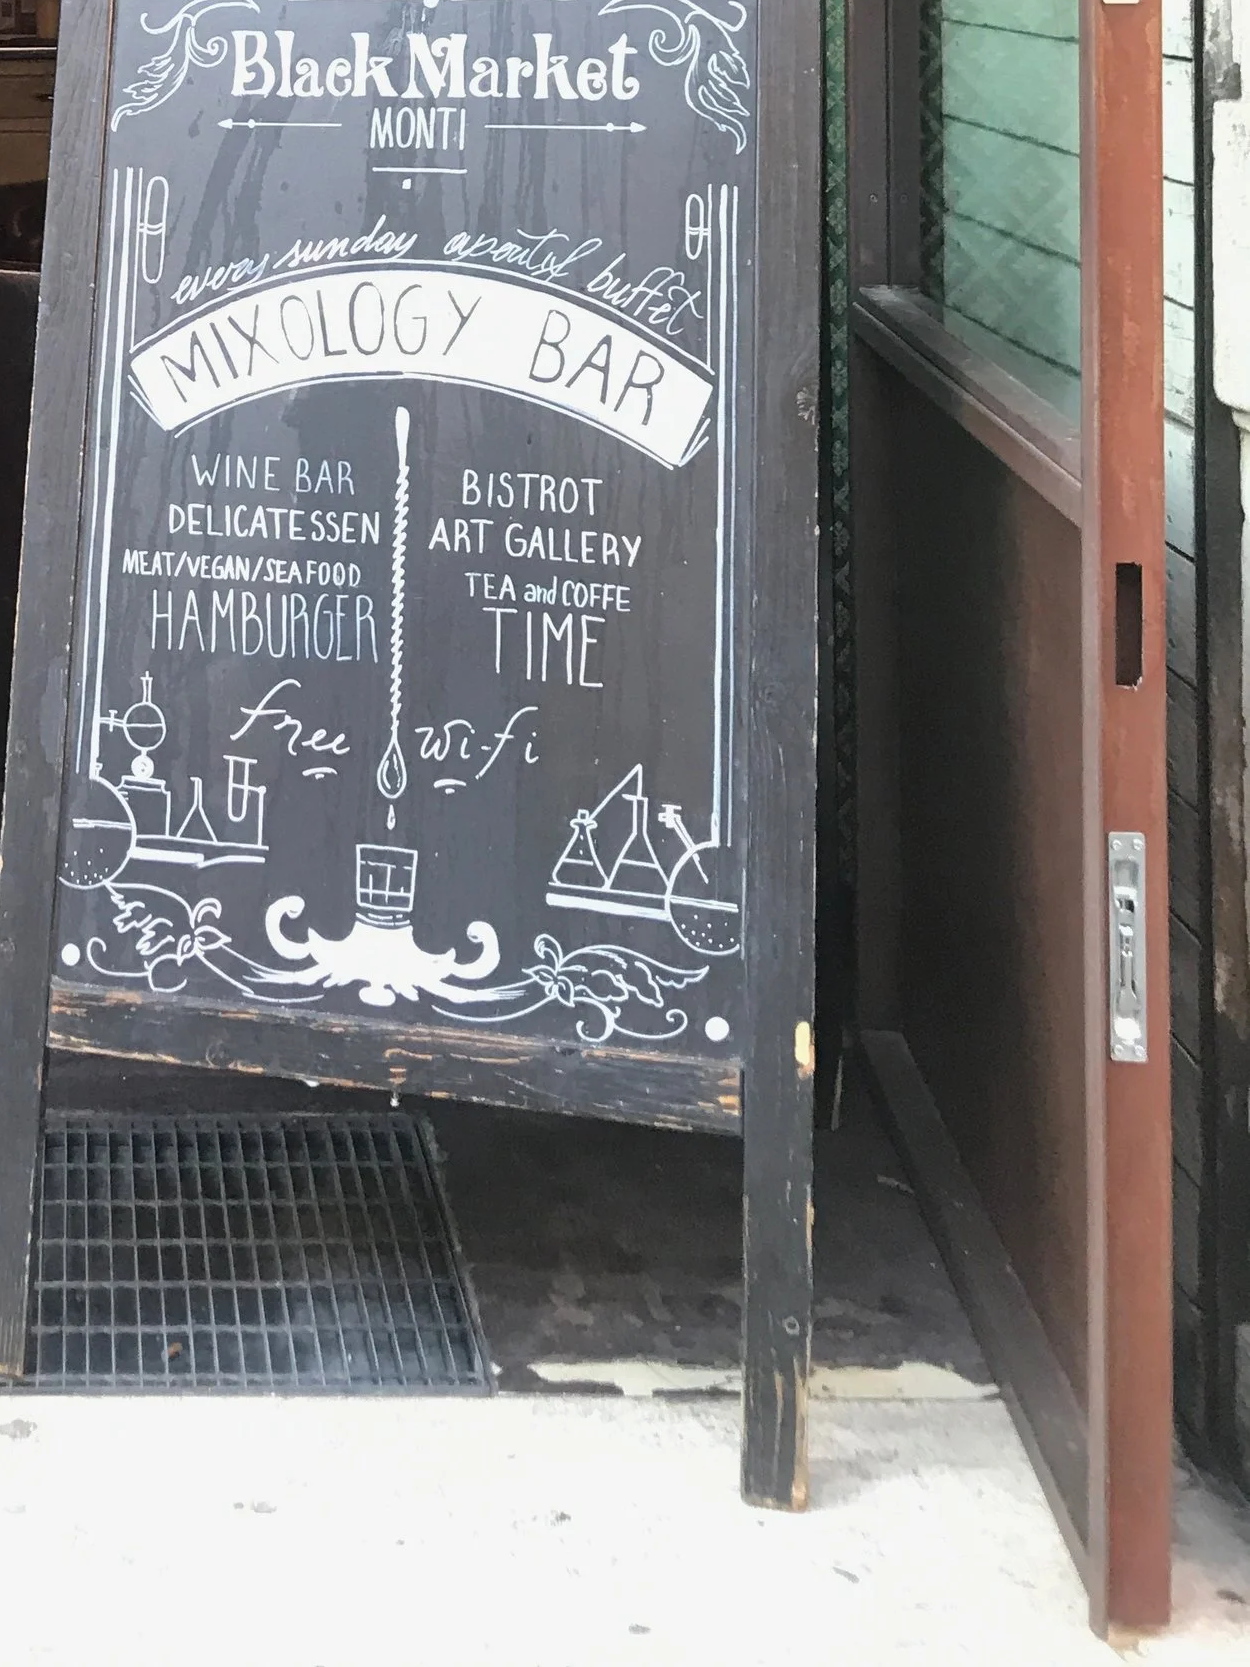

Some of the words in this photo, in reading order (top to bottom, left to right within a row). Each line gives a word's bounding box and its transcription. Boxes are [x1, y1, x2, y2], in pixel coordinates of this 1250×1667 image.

[230, 29, 399, 99] Black
[400, 30, 640, 102] Market
[369, 107, 467, 151] MONTI
[170, 251, 270, 304] every
[272, 214, 419, 270] sunday
[587, 252, 705, 335] buffet
[159, 281, 482, 403] MIXOLOGY
[528, 309, 665, 426] BAR
[190, 452, 281, 492] WINE
[295, 457, 355, 496] BAR
[461, 468, 604, 516] BISTROT
[168, 502, 380, 545] DELICATESSEN
[428, 517, 495, 554] ART
[504, 522, 642, 568] GALLERY
[464, 572, 517, 602] TEA
[523, 575, 558, 605] and
[561, 579, 631, 612] COFFE
[151, 588, 379, 664] HAMBURGER
[482, 606, 606, 688] TIME
[229, 678, 351, 756] free
[414, 705, 540, 780] wi-fi
